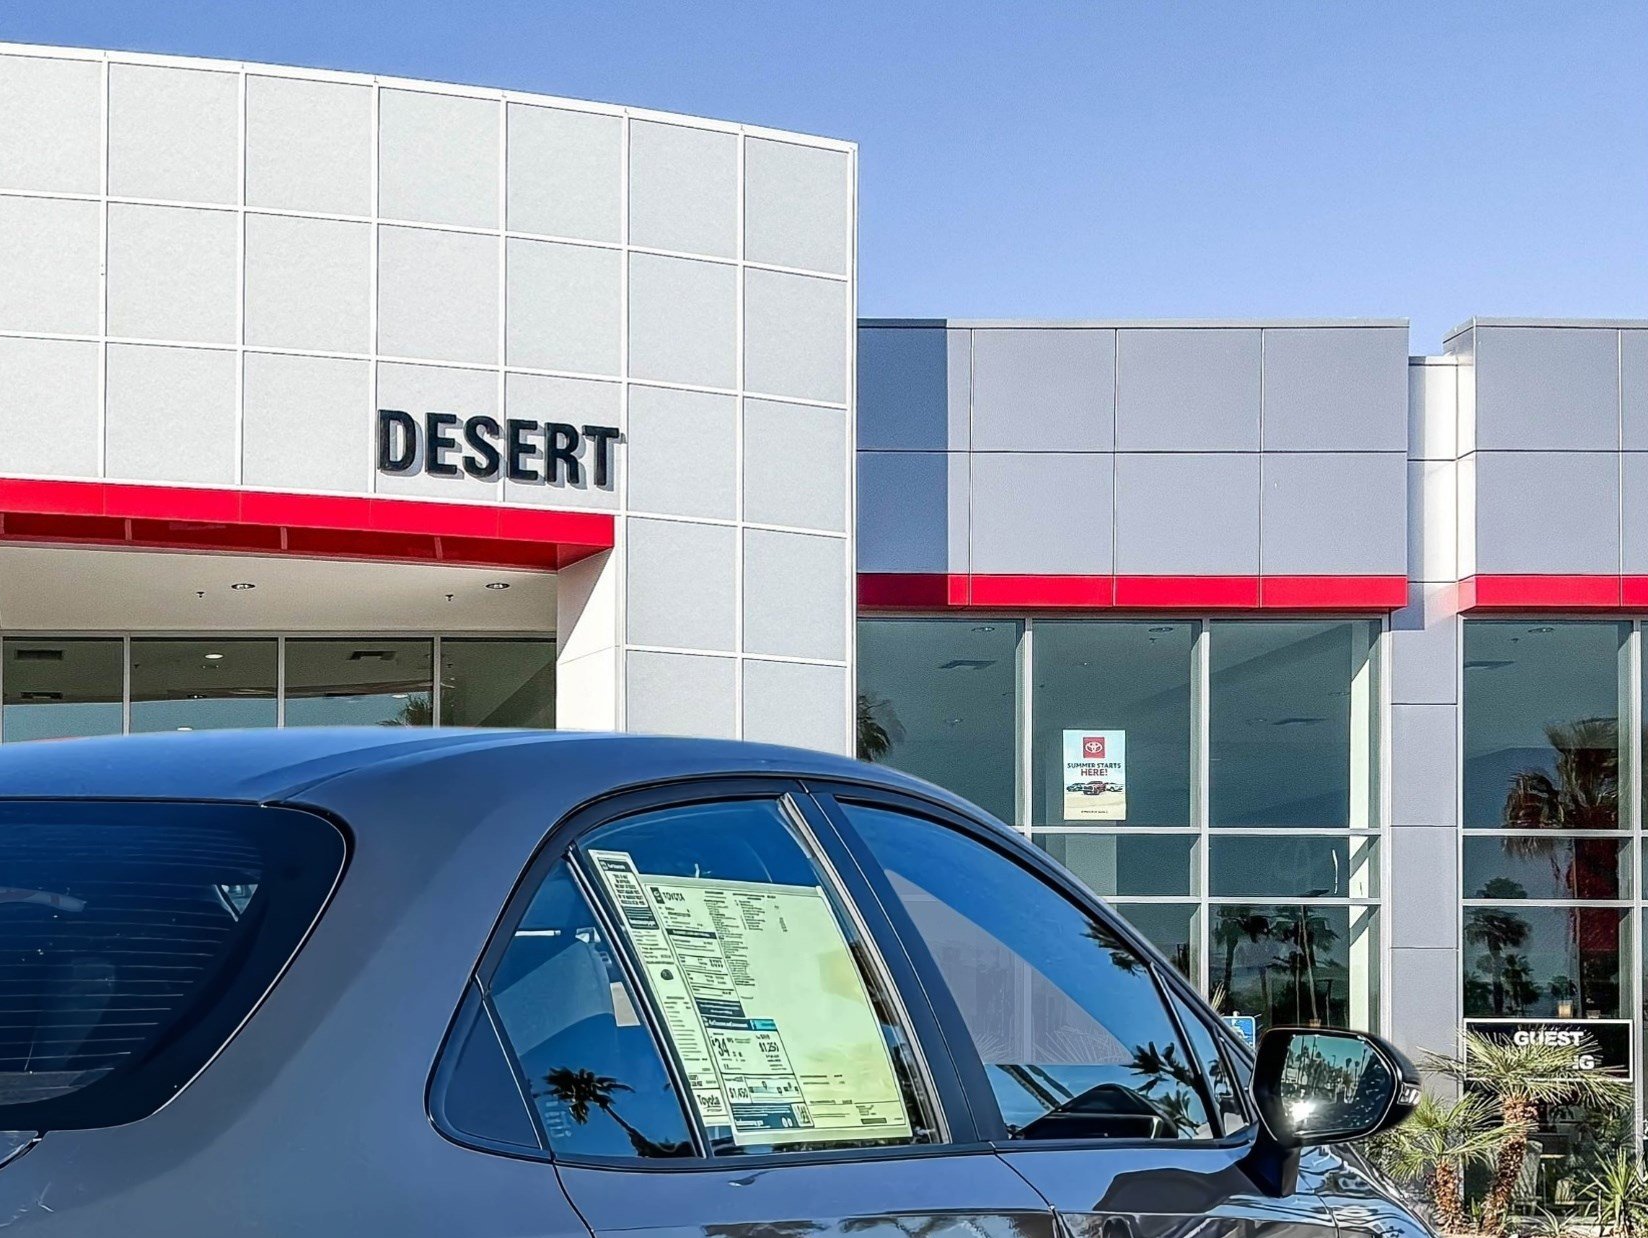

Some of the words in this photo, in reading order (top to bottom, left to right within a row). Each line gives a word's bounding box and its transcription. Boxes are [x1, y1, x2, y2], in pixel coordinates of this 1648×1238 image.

[376, 409, 620, 487] DESERT
[1080, 768, 1108, 776] HERE!
[1513, 1030, 1585, 1047] GUEST
